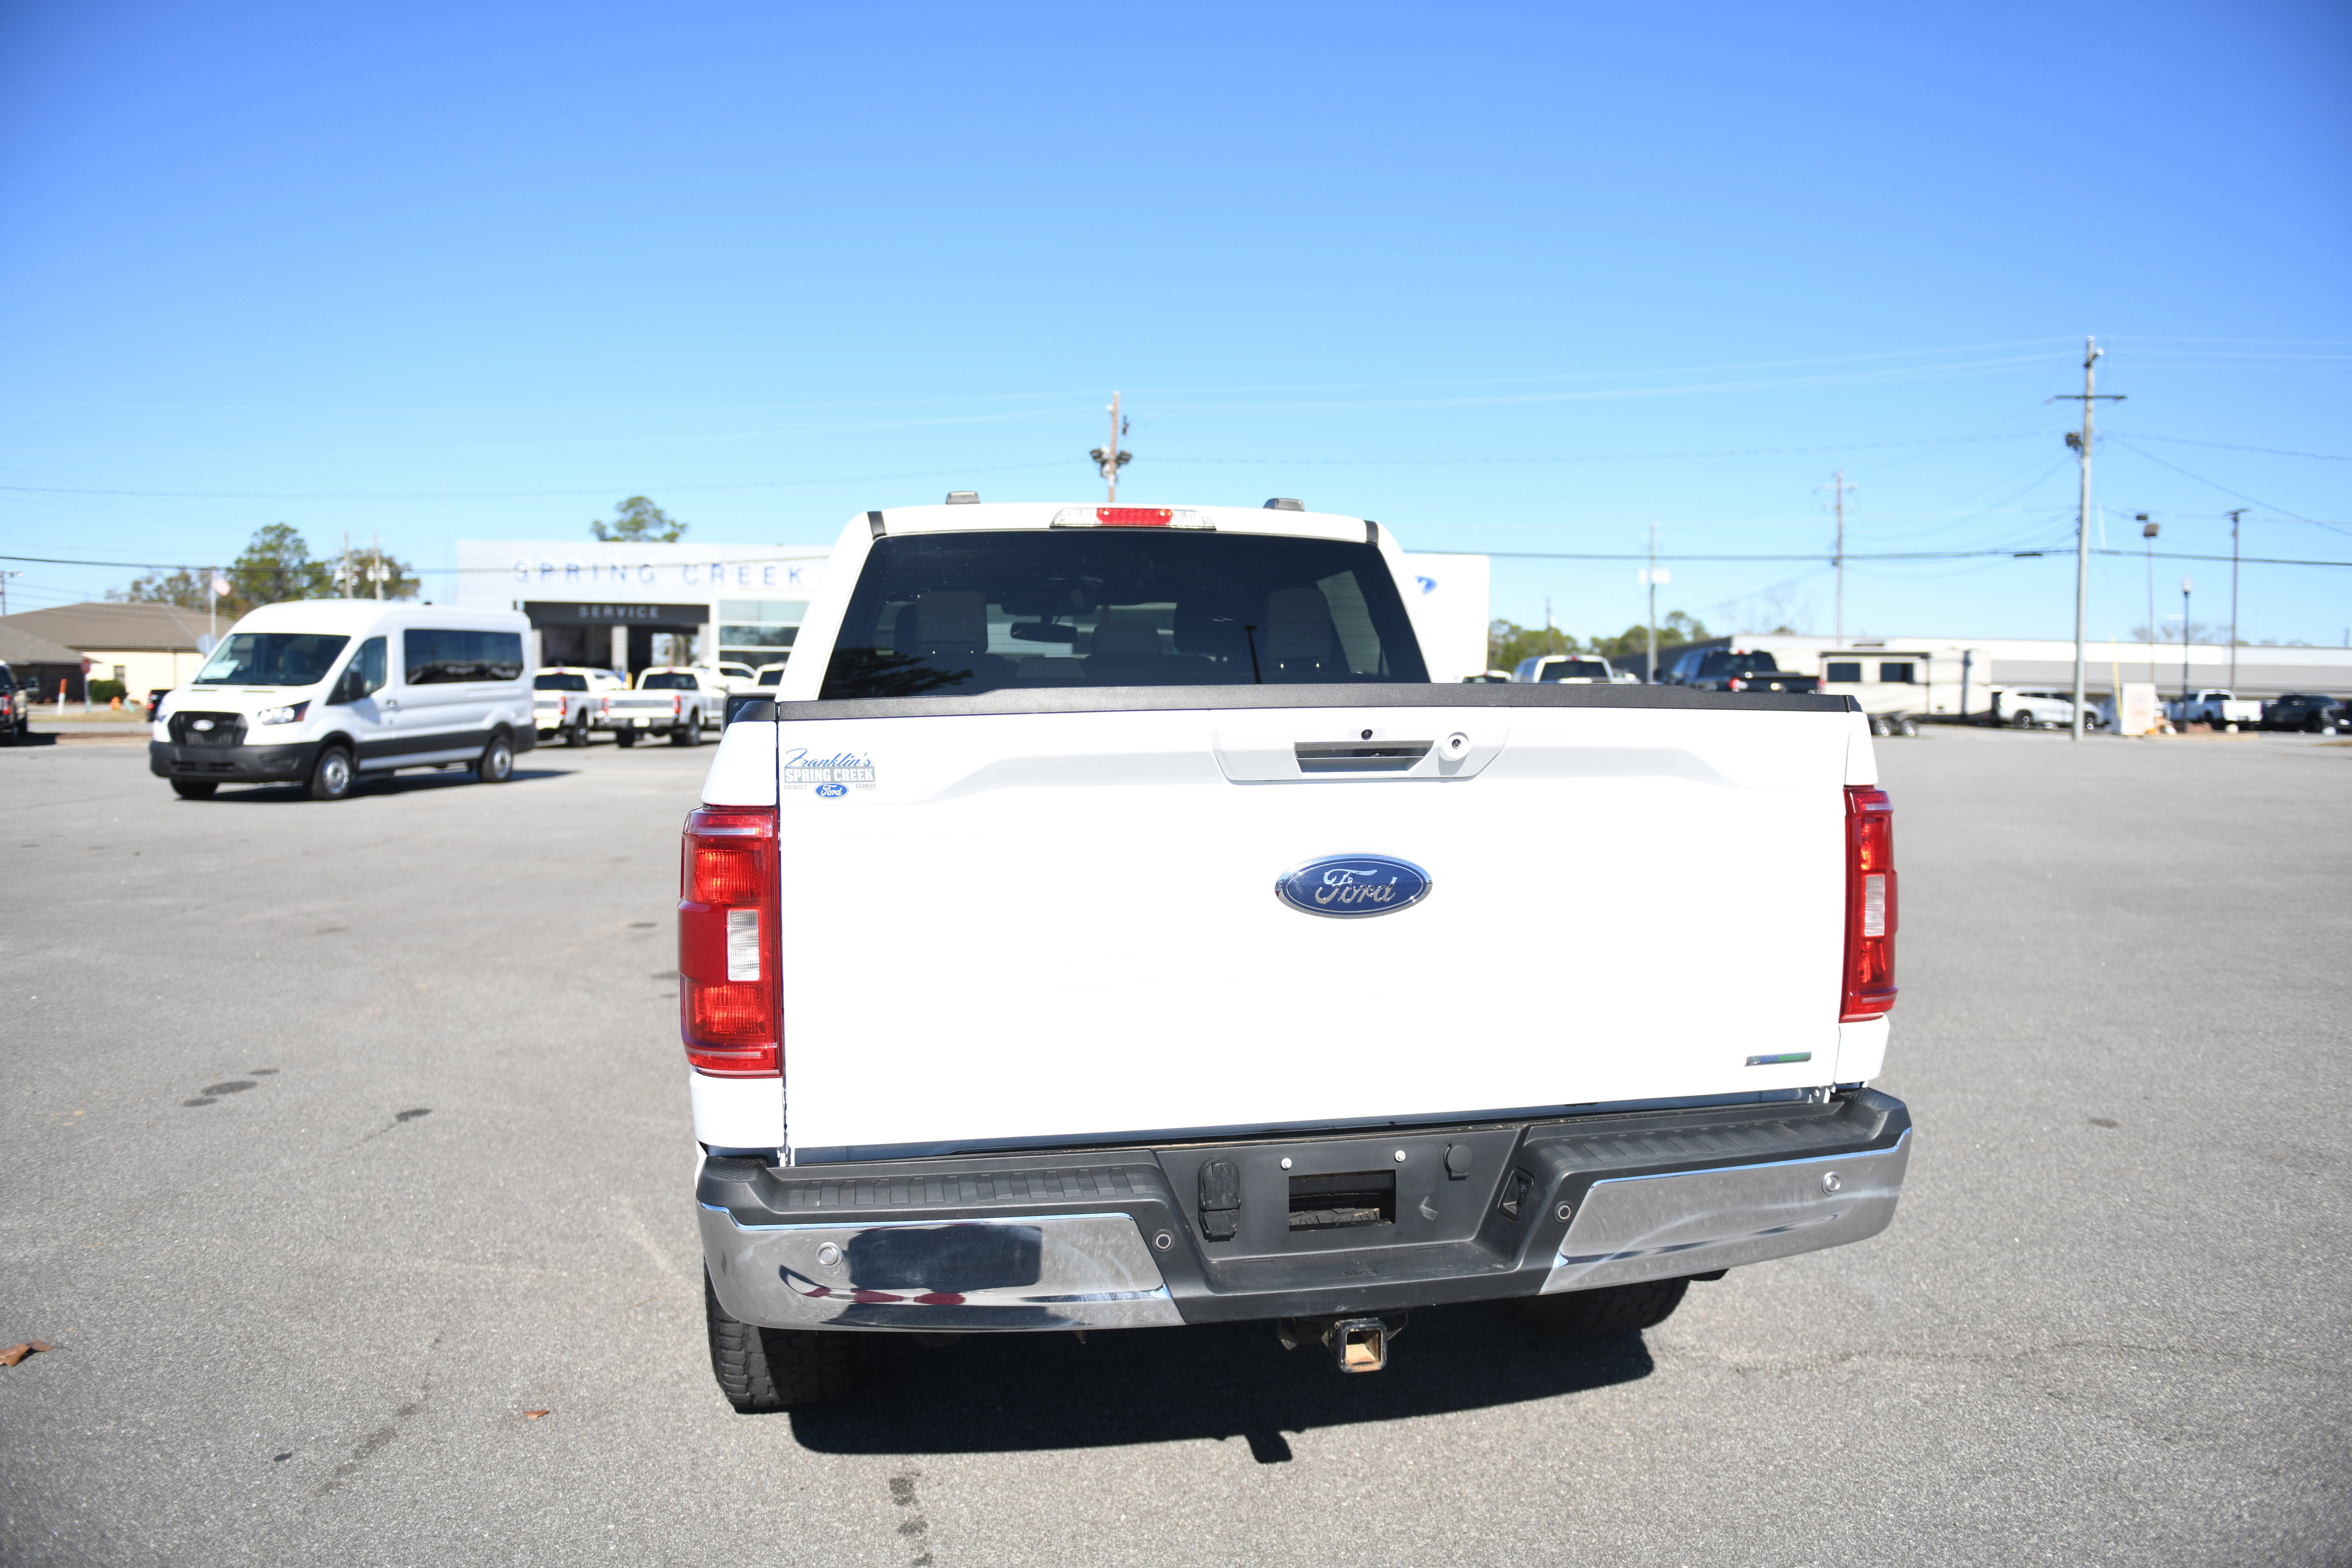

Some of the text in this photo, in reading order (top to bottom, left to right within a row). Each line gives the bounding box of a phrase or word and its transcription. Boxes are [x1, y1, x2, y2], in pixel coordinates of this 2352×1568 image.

[513, 562, 802, 585] SPRING CREEK
[579, 605, 659, 618] SERVICE
[785, 748, 873, 768] Franklin's
[785, 768, 873, 782] SPRING CREEK
[820, 784, 842, 796] Ford
[1315, 868, 1398, 904] Ford
